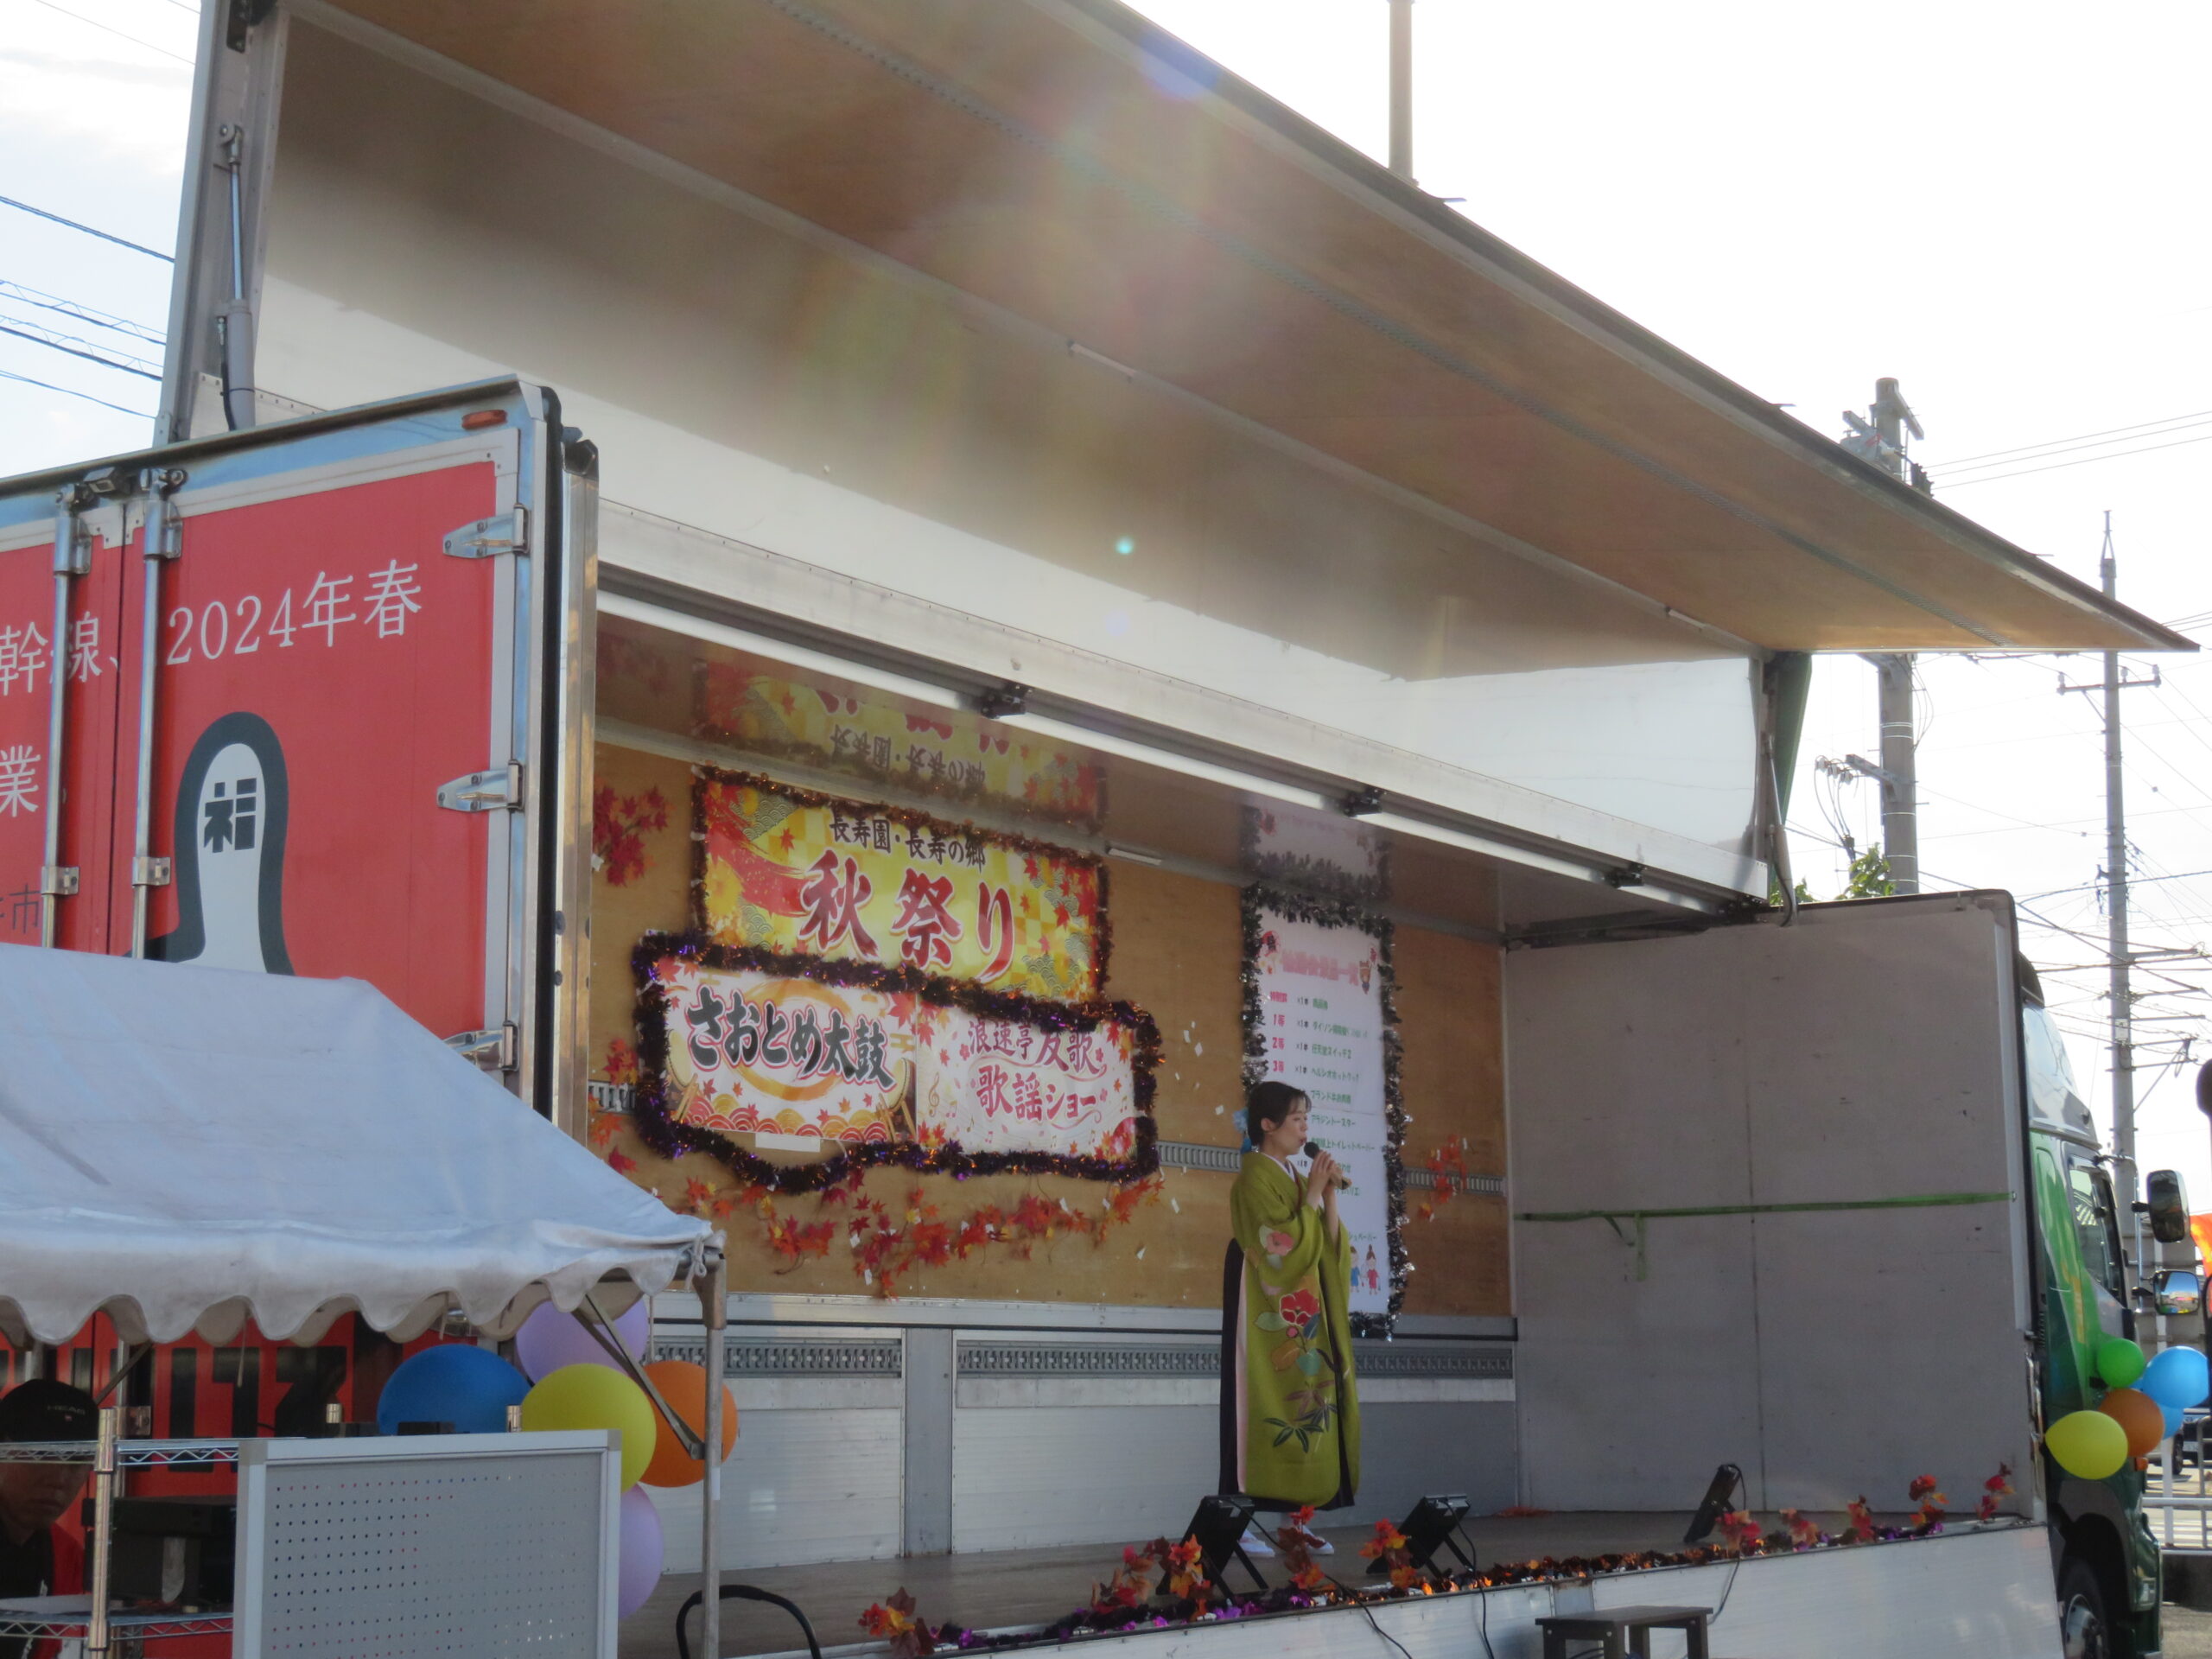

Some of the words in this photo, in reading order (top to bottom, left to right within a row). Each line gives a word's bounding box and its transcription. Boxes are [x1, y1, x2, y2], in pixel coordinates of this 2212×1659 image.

[167, 560, 422, 665] 2024年春
[0, 883, 41, 935] 市
[798, 849, 1015, 982] 秋祭り
[687, 985, 896, 1089] さおとめ太鼓
[976, 1064, 1097, 1122] 歌謡ショー
